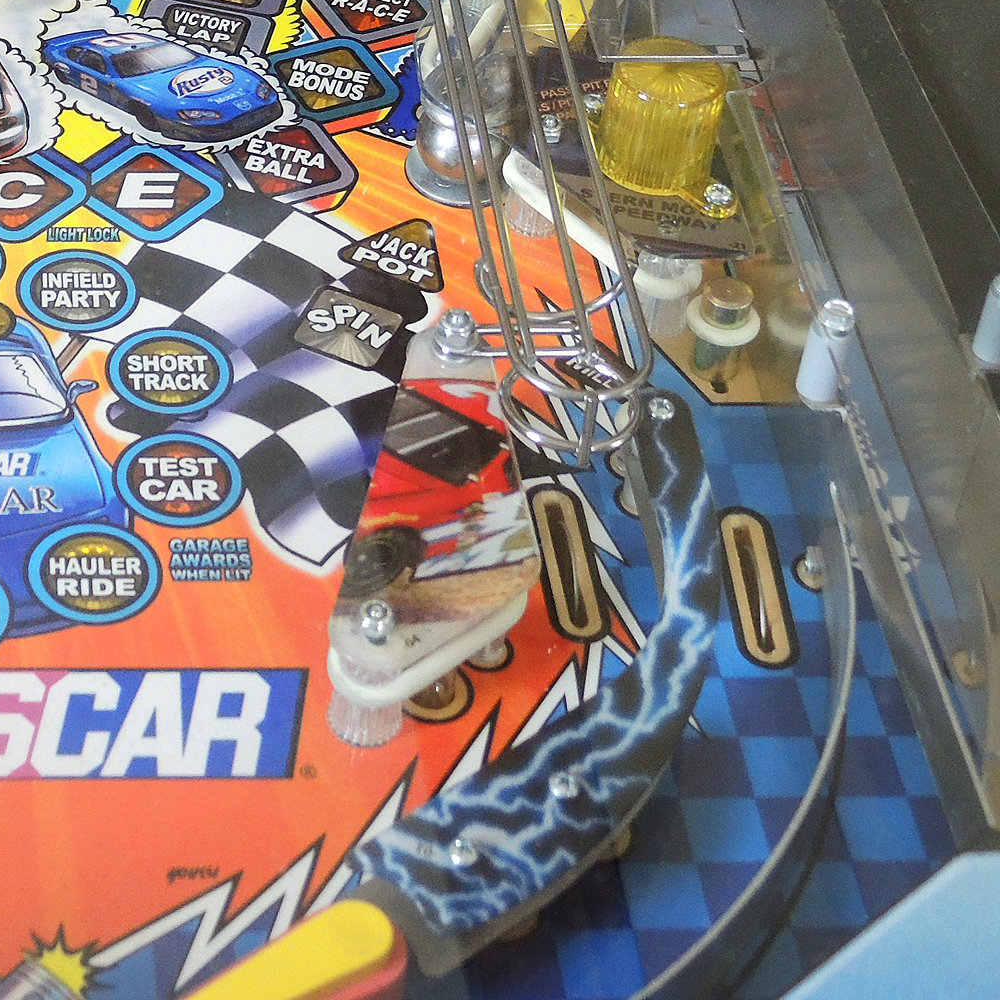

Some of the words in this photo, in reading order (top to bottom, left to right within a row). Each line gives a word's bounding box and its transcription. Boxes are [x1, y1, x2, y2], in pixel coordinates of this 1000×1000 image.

[173, 9, 242, 34] VICTORY
[175, 25, 231, 43] LAP
[176, 67, 225, 98] Rusty
[291, 58, 372, 86] MODE
[287, 71, 364, 101] BONUS
[246, 138, 326, 170] EXTRA
[246, 156, 313, 186] BALL
[47, 227, 83, 242] LIGHT
[85, 227, 120, 242] LOCK
[370, 232, 434, 267] JACK
[351, 249, 433, 283] POT
[41, 272, 116, 289] INFIELD
[40, 289, 121, 309] PARTY
[306, 304, 392, 349] SPIN
[127, 354, 208, 373] SHORT
[128, 371, 209, 392] TRACK
[138, 456, 217, 477] TEST
[140, 477, 219, 503] CAR
[170, 538, 249, 553] GARAGE
[49, 556, 142, 577] HAULER
[169, 552, 252, 568] AWARDS
[170, 568, 220, 582] WHEN
[224, 568, 251, 582] LIT
[56, 576, 136, 597] RIDE
